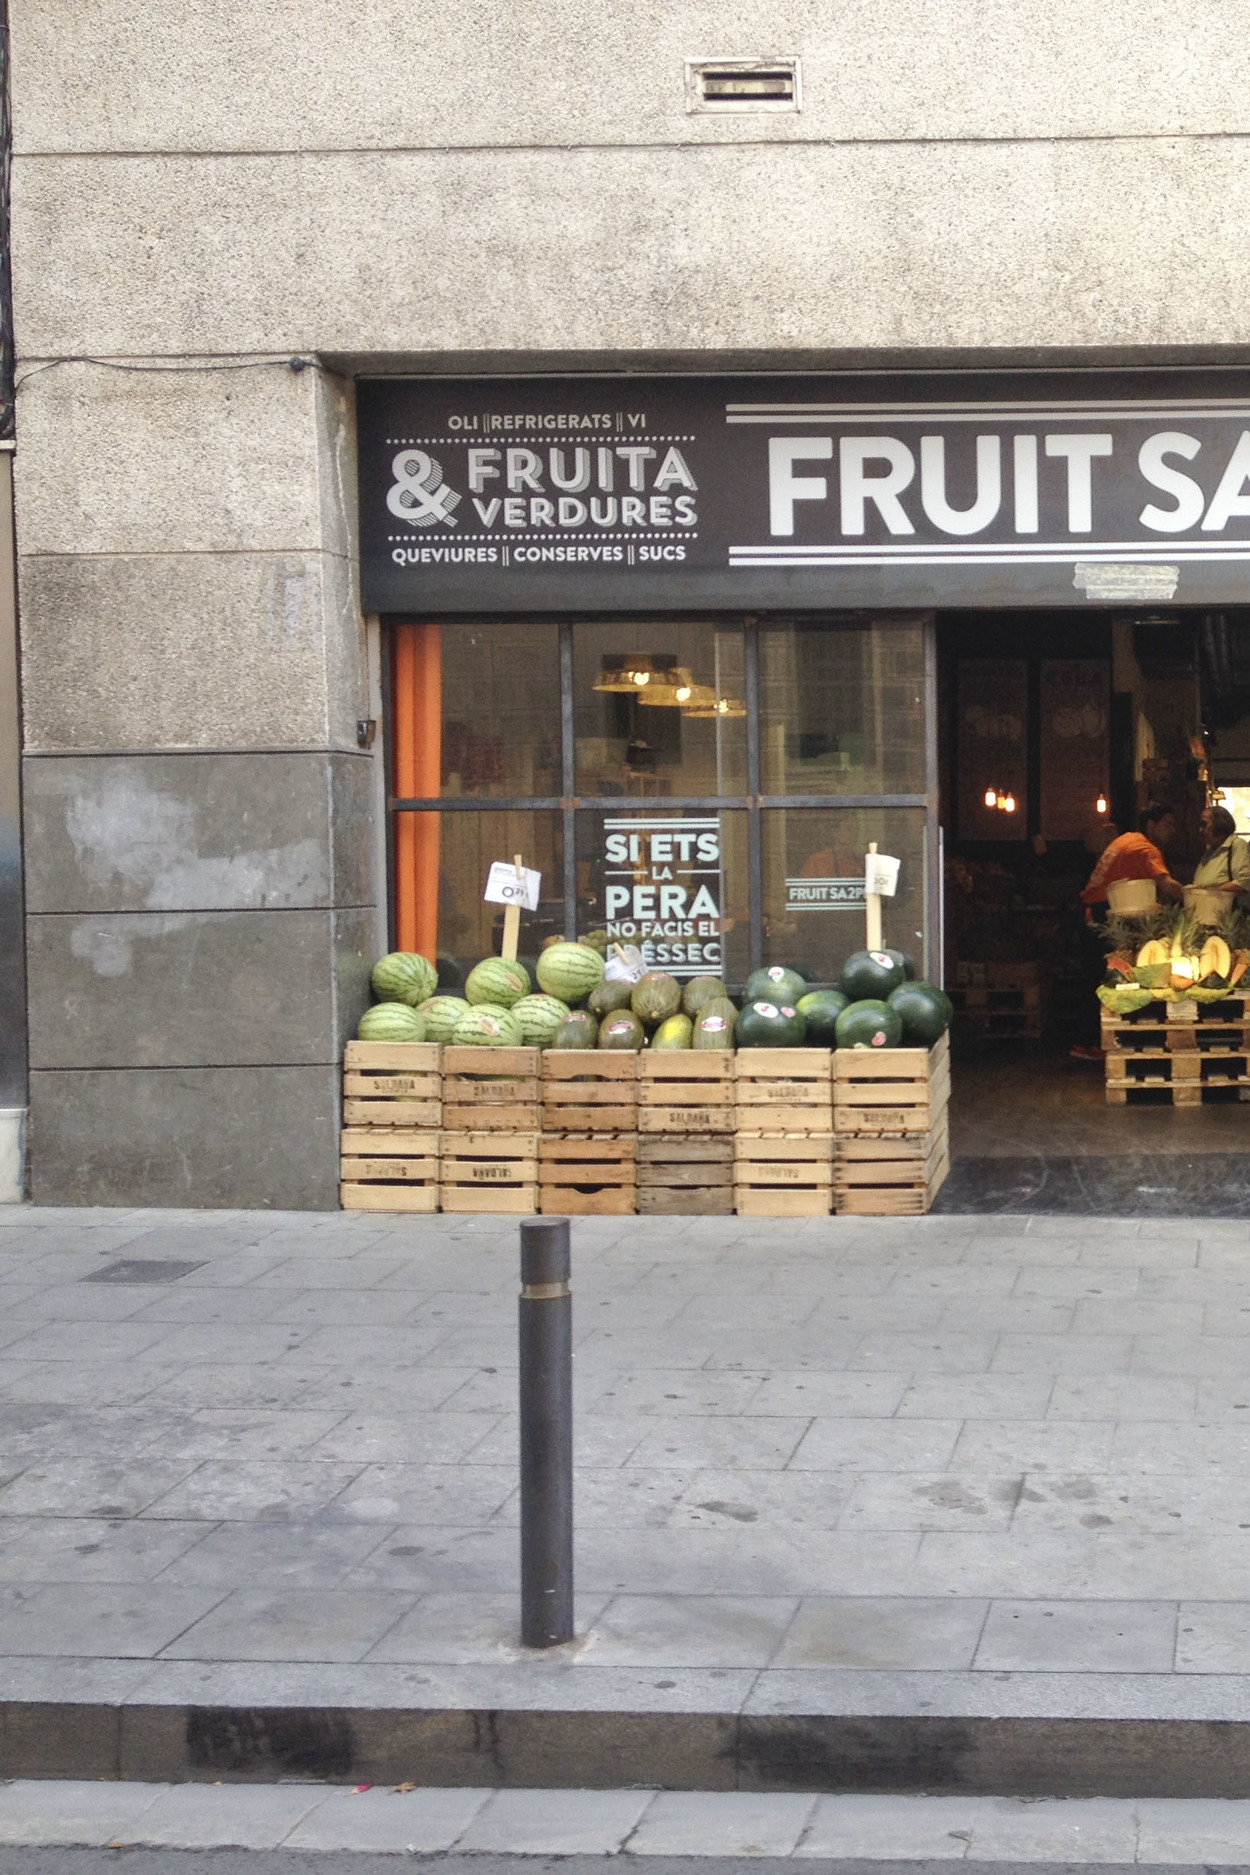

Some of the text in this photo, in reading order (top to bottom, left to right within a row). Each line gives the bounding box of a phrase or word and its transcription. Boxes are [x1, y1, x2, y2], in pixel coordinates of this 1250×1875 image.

[448, 413, 647, 430] OLI REFRIGERATS VI
[386, 445, 699, 528] & FRUITA
[768, 433, 1113, 538] FRUIT
[472, 495, 699, 528] VERDURES
[391, 545, 687, 567] QUEVIURES CONSERVES SUCS
[605, 833, 720, 862] SI ETS
[652, 866, 673, 880] LA
[605, 884, 720, 920] PERA
[789, 888, 829, 900] FRUIT
[606, 921, 720, 937] NO FACIS EL
